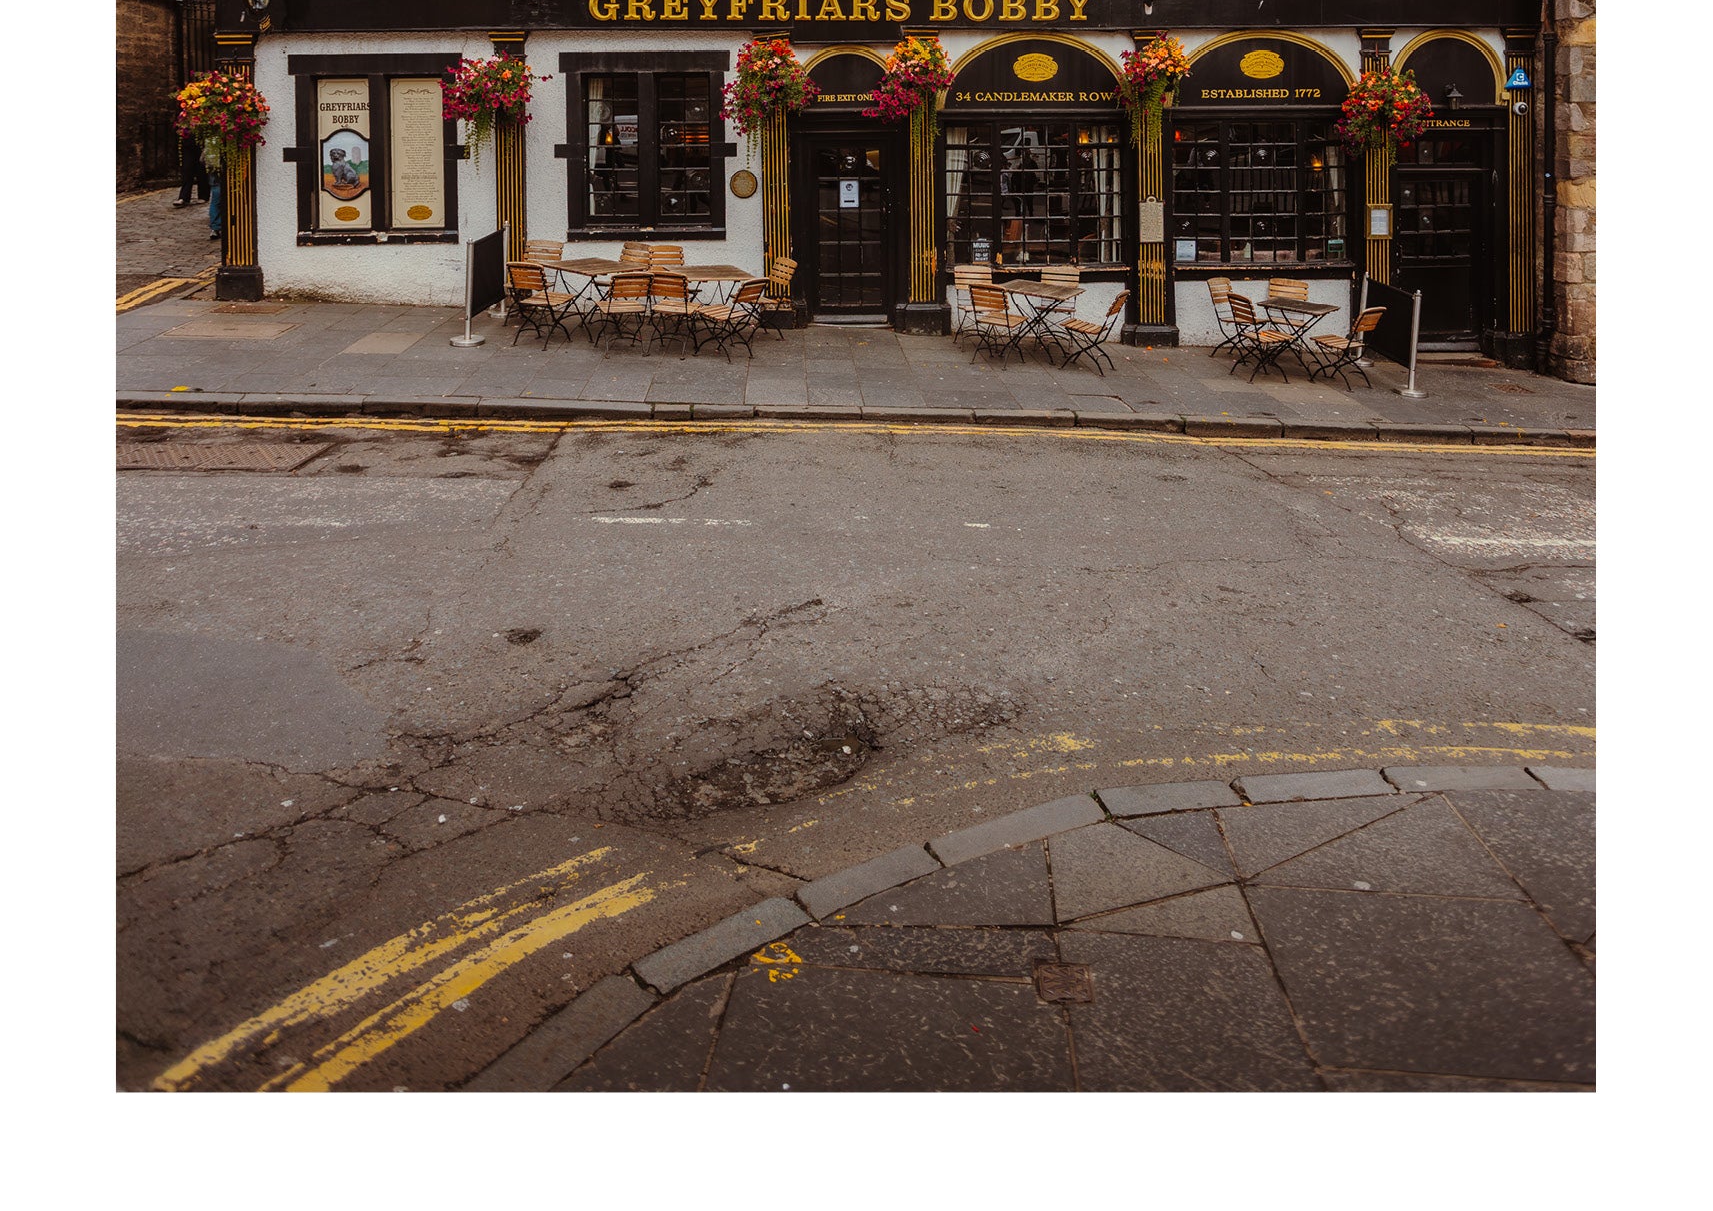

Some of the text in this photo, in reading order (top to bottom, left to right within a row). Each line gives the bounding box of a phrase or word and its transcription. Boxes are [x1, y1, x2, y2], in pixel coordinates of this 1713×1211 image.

[817, 93, 875, 102] FIRE EXIT ONL
[955, 92, 1114, 102] 34 CANDLEMAKER ROW
[1201, 88, 1321, 99] ESTABLISHED 1772
[320, 102, 371, 111] GREYFRIARS
[332, 115, 359, 124] BOBBY
